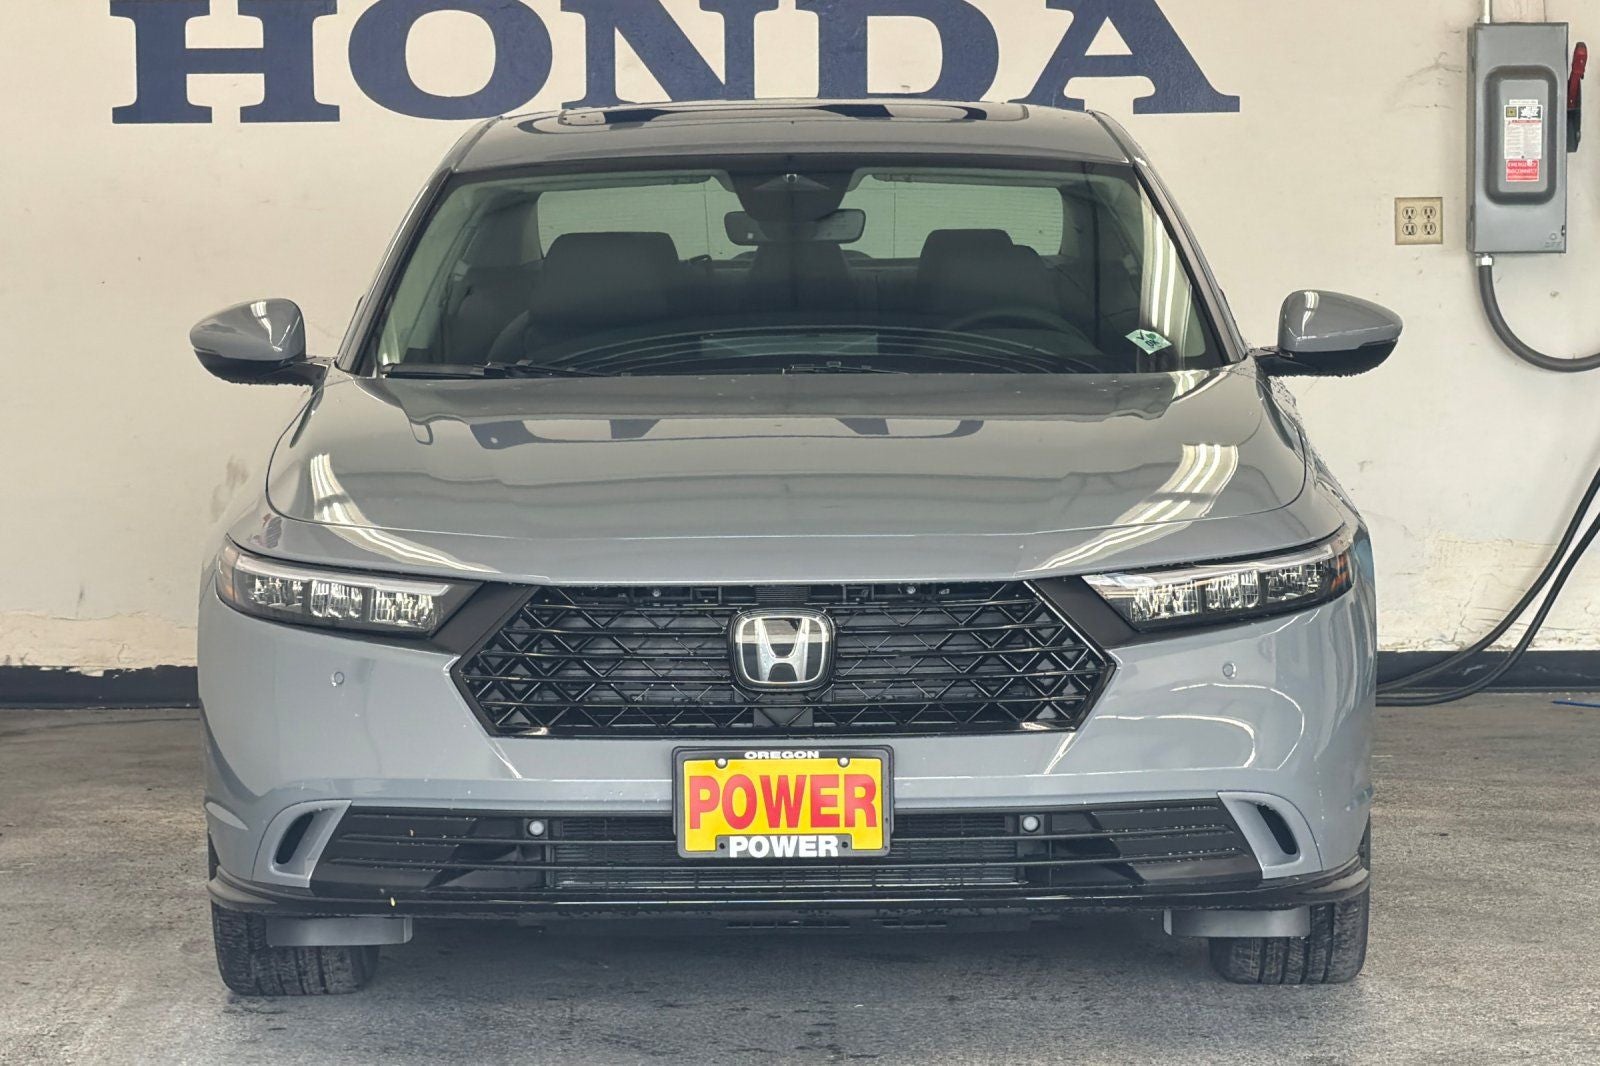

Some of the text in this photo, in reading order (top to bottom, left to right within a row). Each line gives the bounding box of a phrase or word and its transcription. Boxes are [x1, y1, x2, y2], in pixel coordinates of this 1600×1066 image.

[110, 0, 1240, 125] HONDA
[744, 750, 820, 760] OREGON
[689, 774, 877, 830] POWER
[729, 835, 839, 858] POWER
